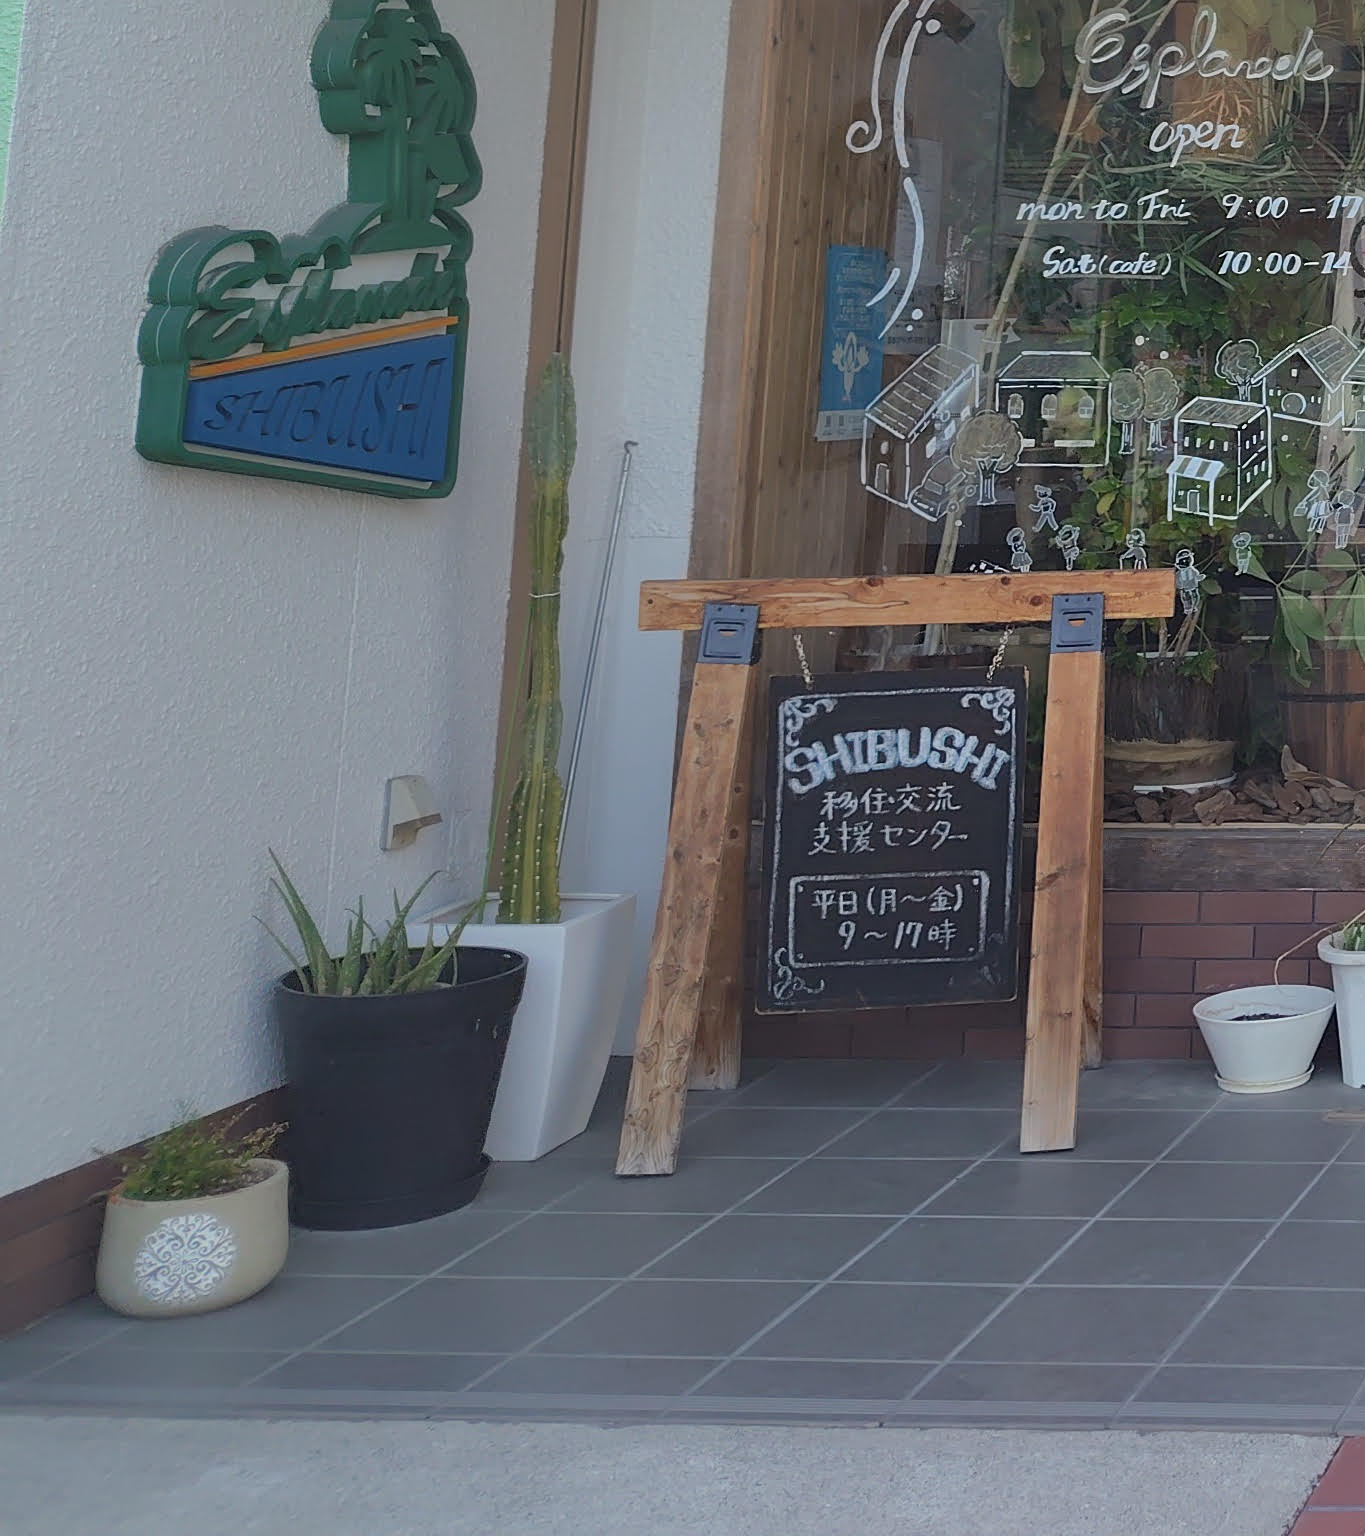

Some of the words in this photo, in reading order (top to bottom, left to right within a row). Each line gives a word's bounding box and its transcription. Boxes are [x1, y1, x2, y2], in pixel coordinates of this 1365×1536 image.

[1075, 5, 1335, 109] Esplanade
[1149, 118, 1246, 167] open
[1091, 197, 1128, 220] to
[1221, 193, 1289, 220] 9:00
[204, 357, 449, 458] SHIBUSHI
[785, 726, 1011, 795] SHIBUSHI
[808, 820, 968, 855] 支援センター
